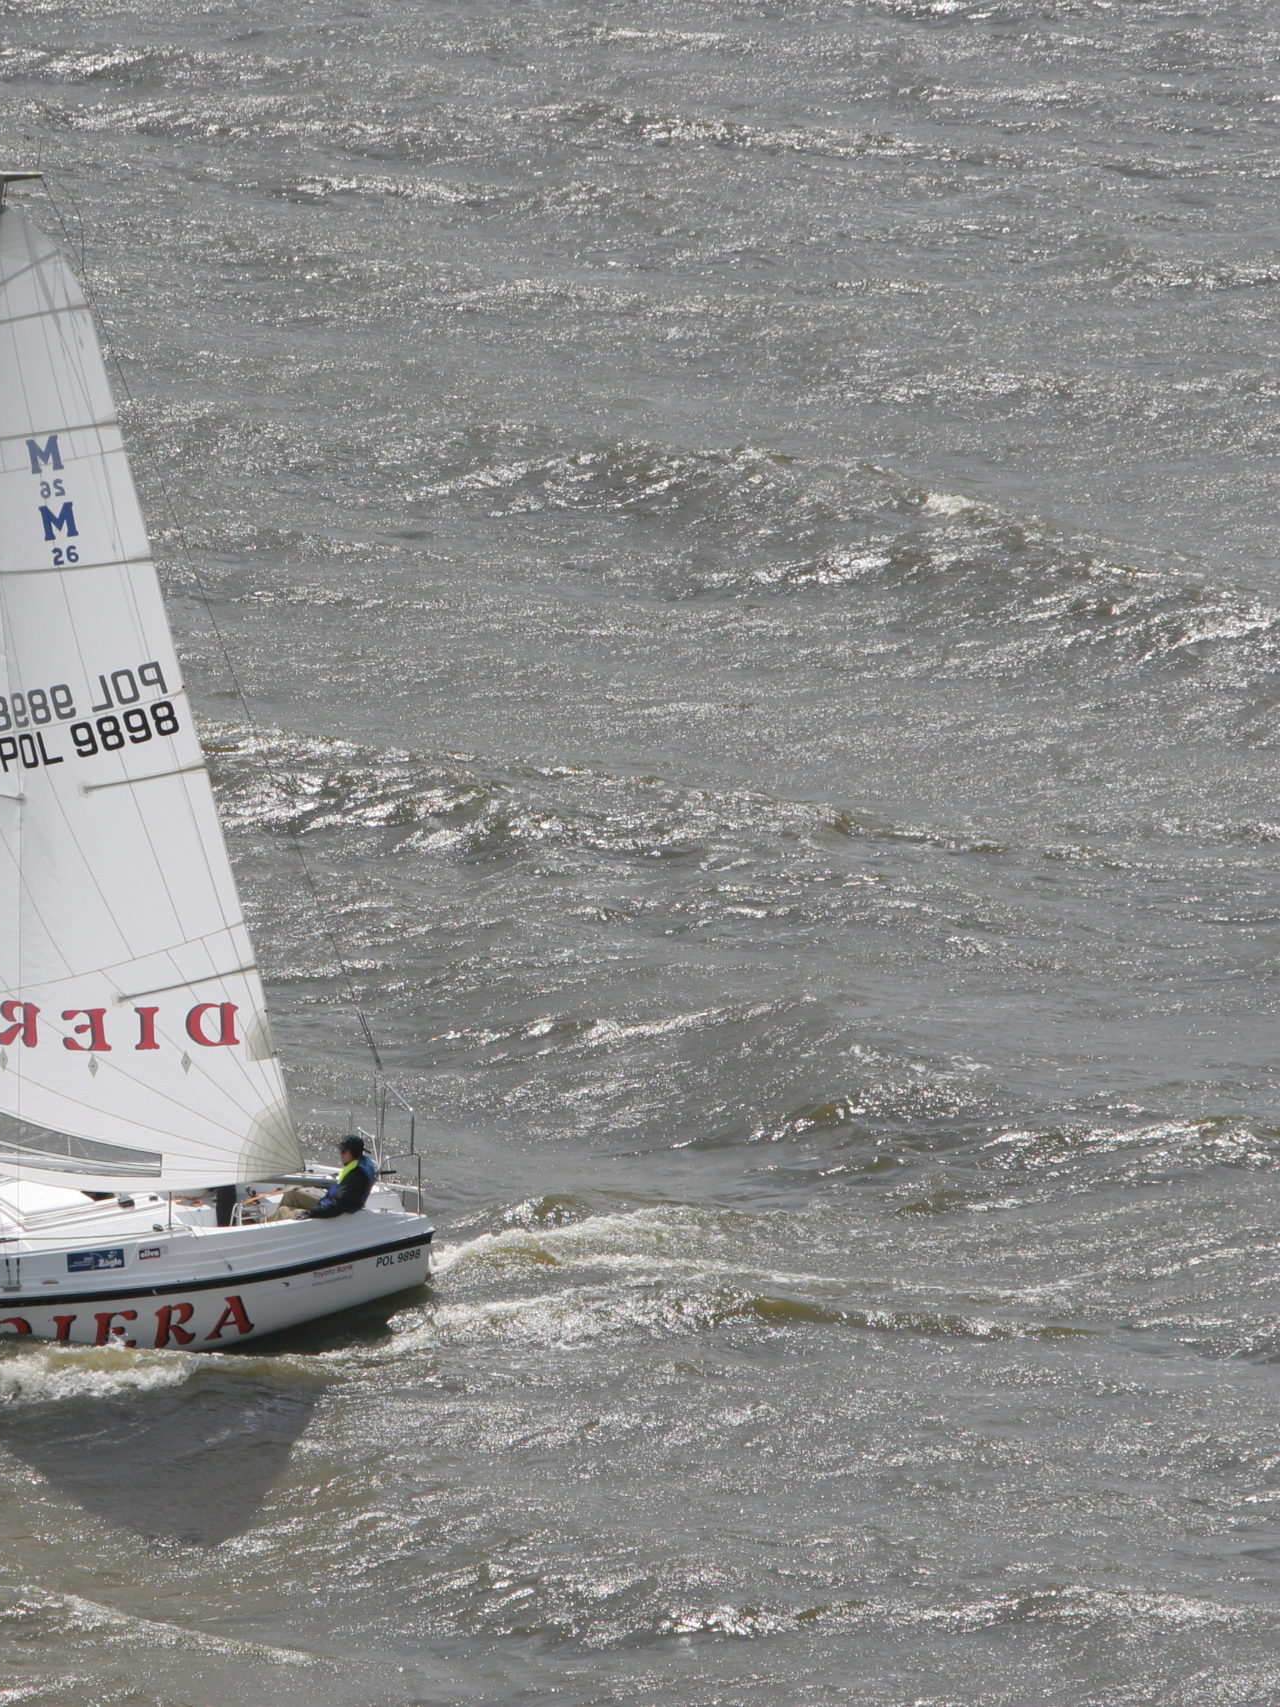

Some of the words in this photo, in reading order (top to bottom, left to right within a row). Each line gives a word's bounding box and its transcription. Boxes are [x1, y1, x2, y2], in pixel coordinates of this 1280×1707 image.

[38, 501, 79, 541] M
[51, 545, 80, 566] 26
[69, 700, 180, 758] 9898
[376, 1255, 394, 1268] POL
[398, 1249, 421, 1262] 9898
